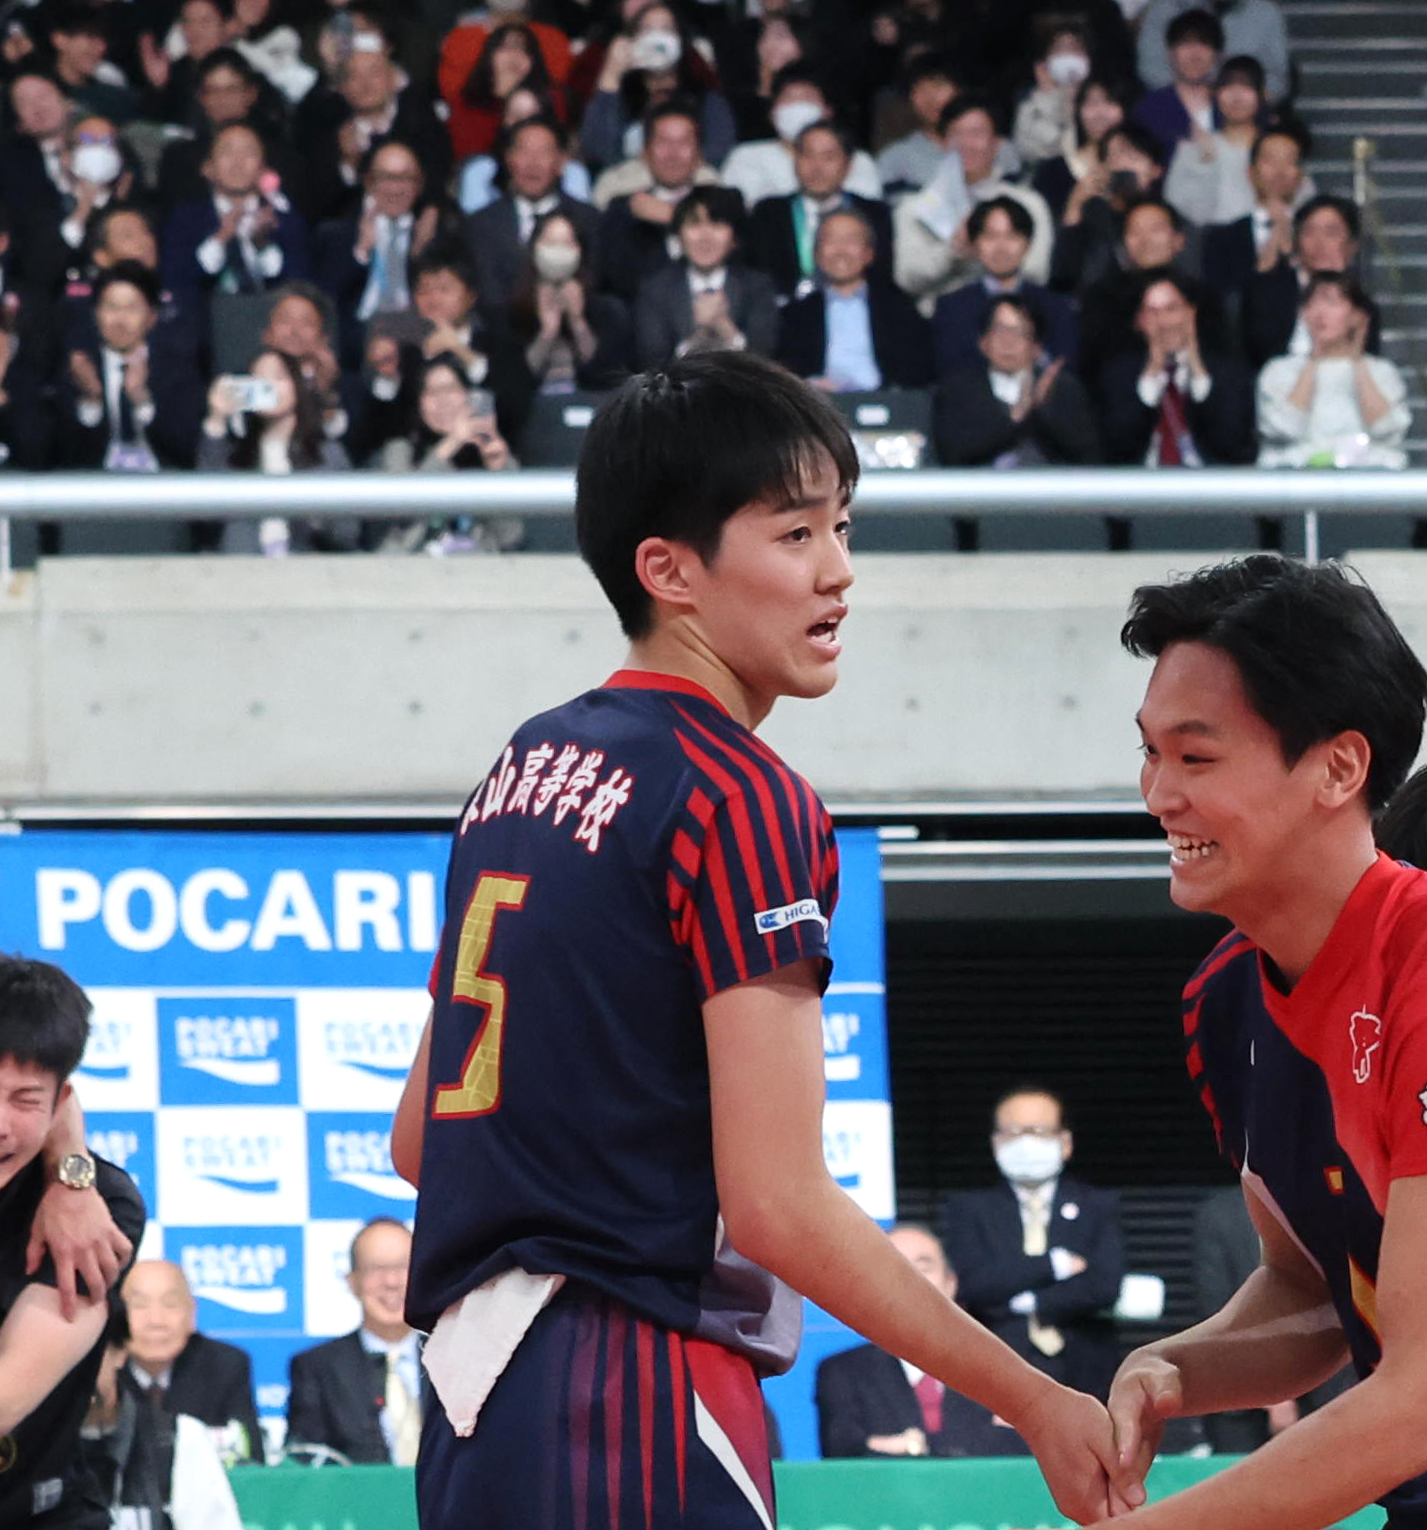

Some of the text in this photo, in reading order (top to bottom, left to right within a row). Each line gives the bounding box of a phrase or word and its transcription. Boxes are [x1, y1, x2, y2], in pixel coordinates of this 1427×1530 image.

[459, 742, 636, 854] 山高等学校
[35, 867, 437, 952] POCARI
[432, 870, 532, 1120] 5
